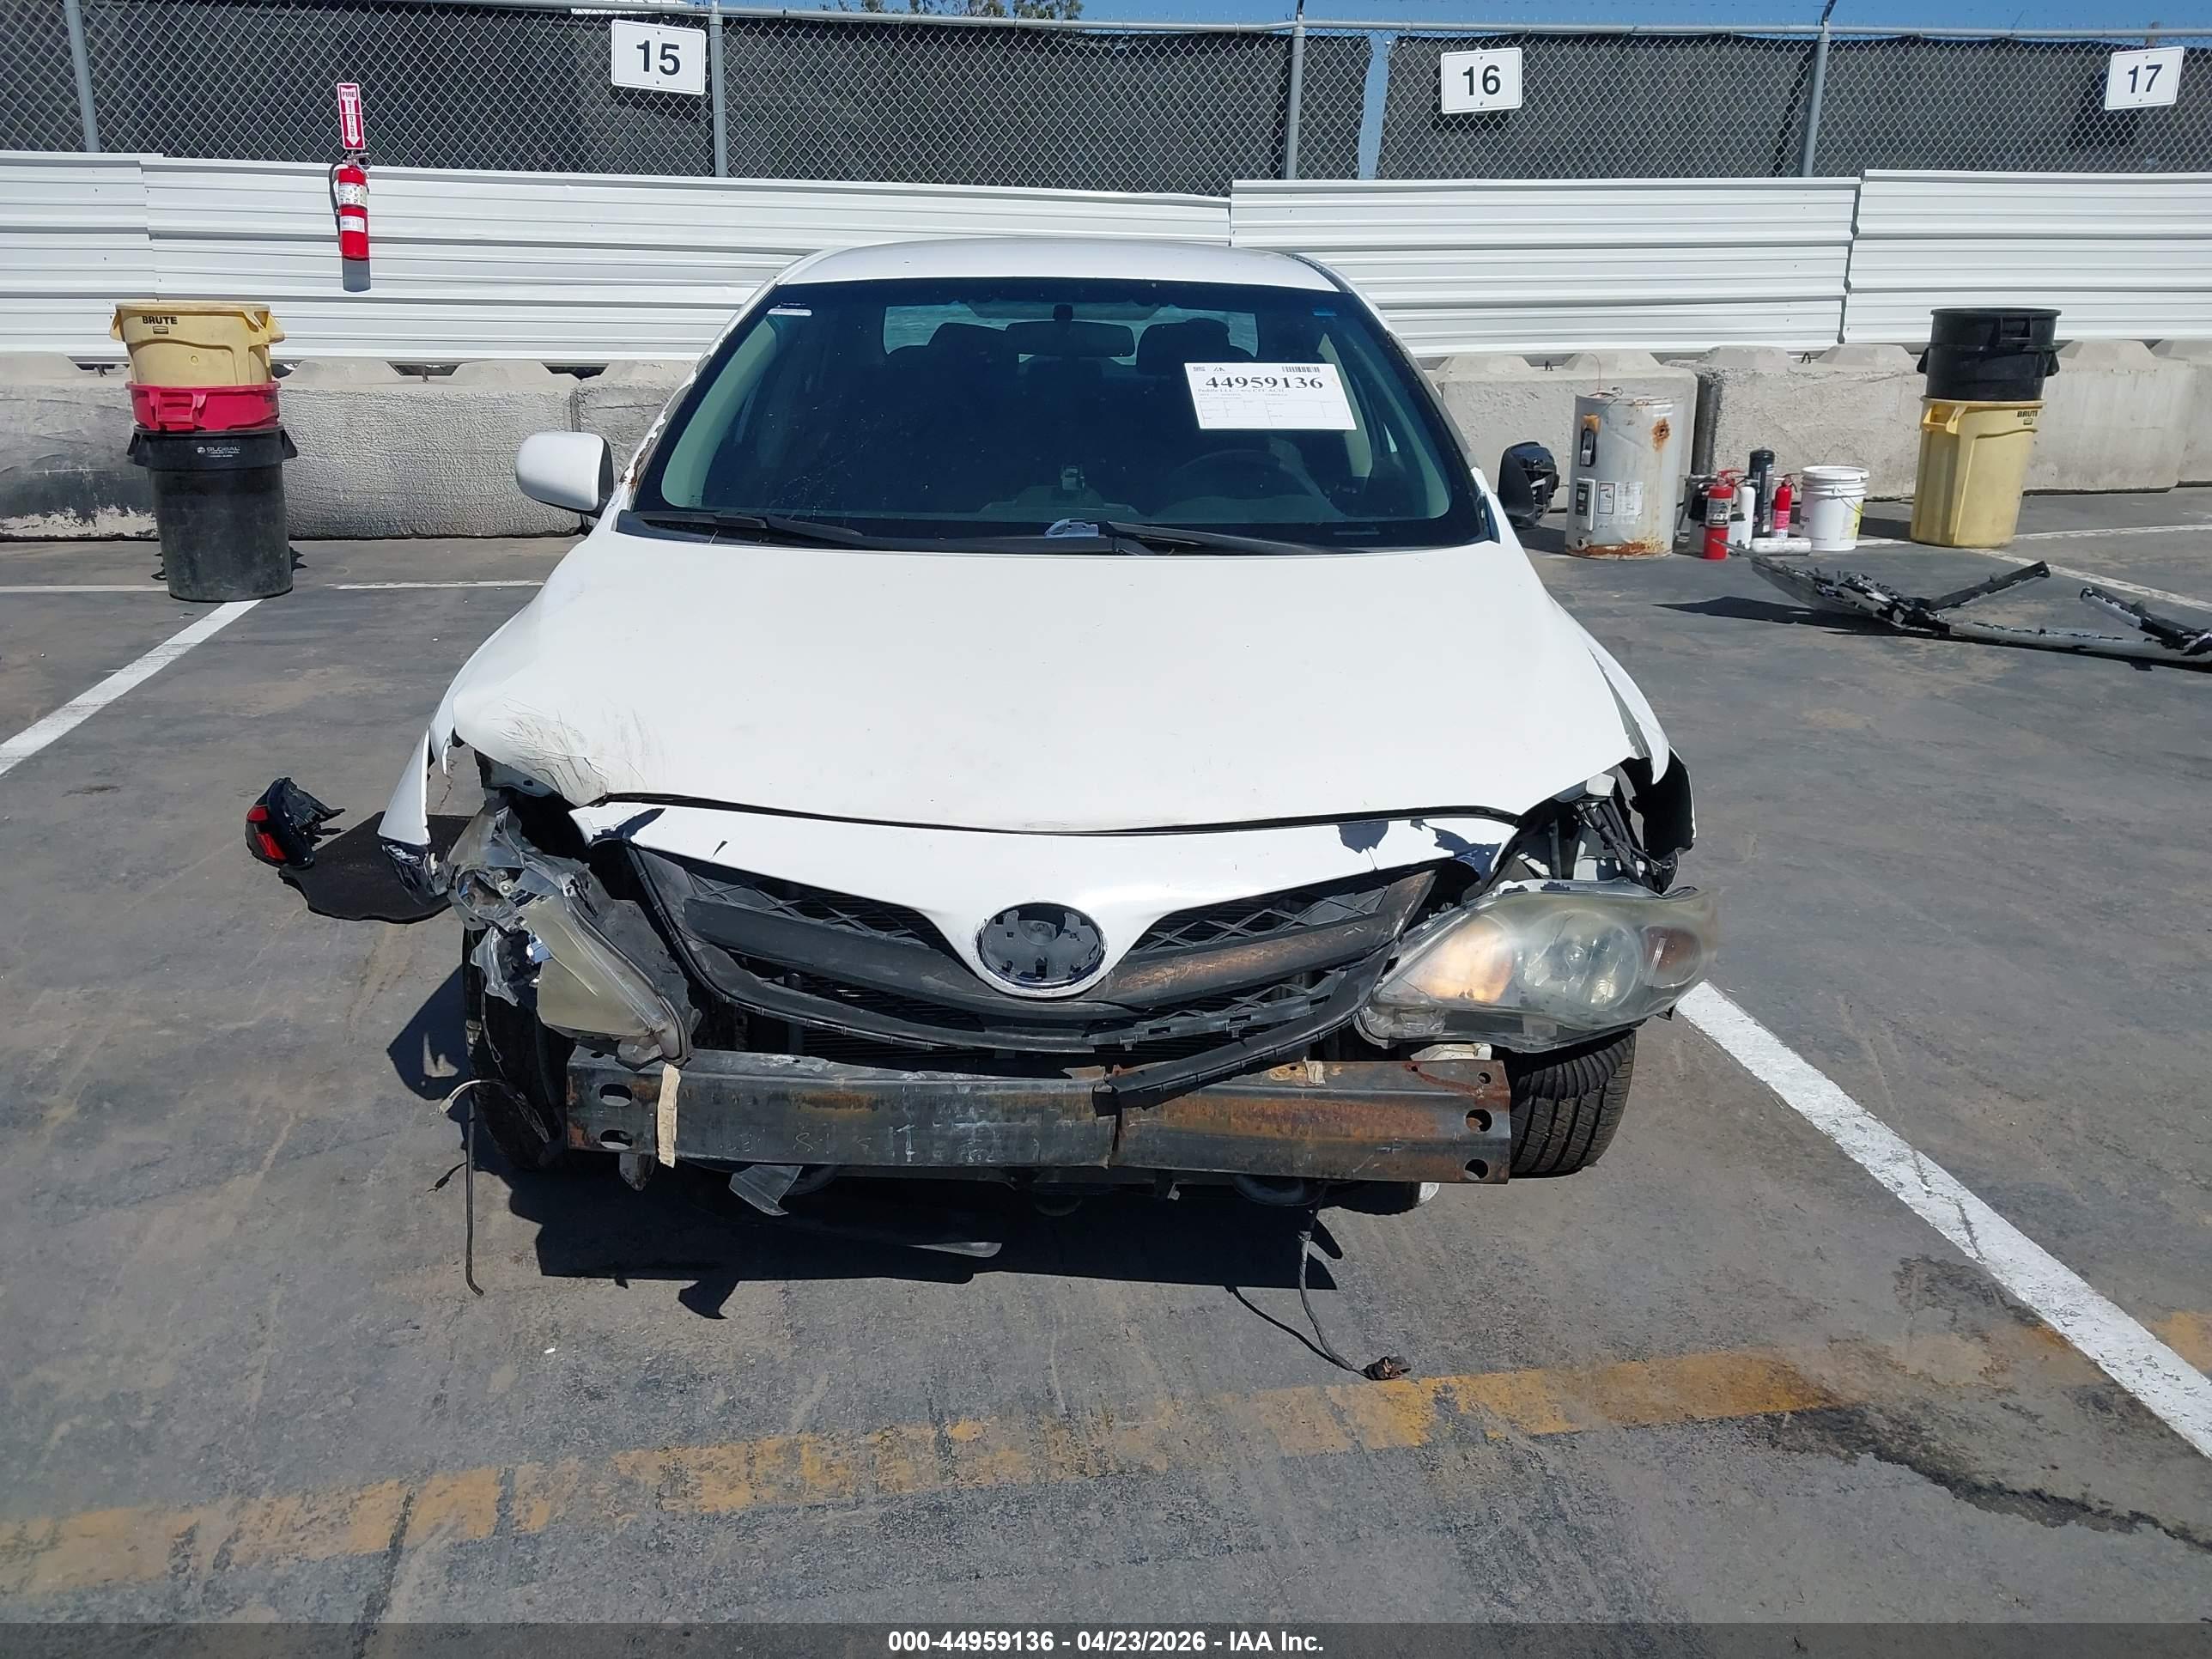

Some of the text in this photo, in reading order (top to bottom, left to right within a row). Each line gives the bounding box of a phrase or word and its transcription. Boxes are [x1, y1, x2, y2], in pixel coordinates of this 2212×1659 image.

[635, 40, 681, 76] 15
[1462, 64, 1502, 96] 16
[2128, 64, 2163, 94] 17
[142, 315, 178, 325] BRUTE
[1206, 376, 1324, 389] 44959136
